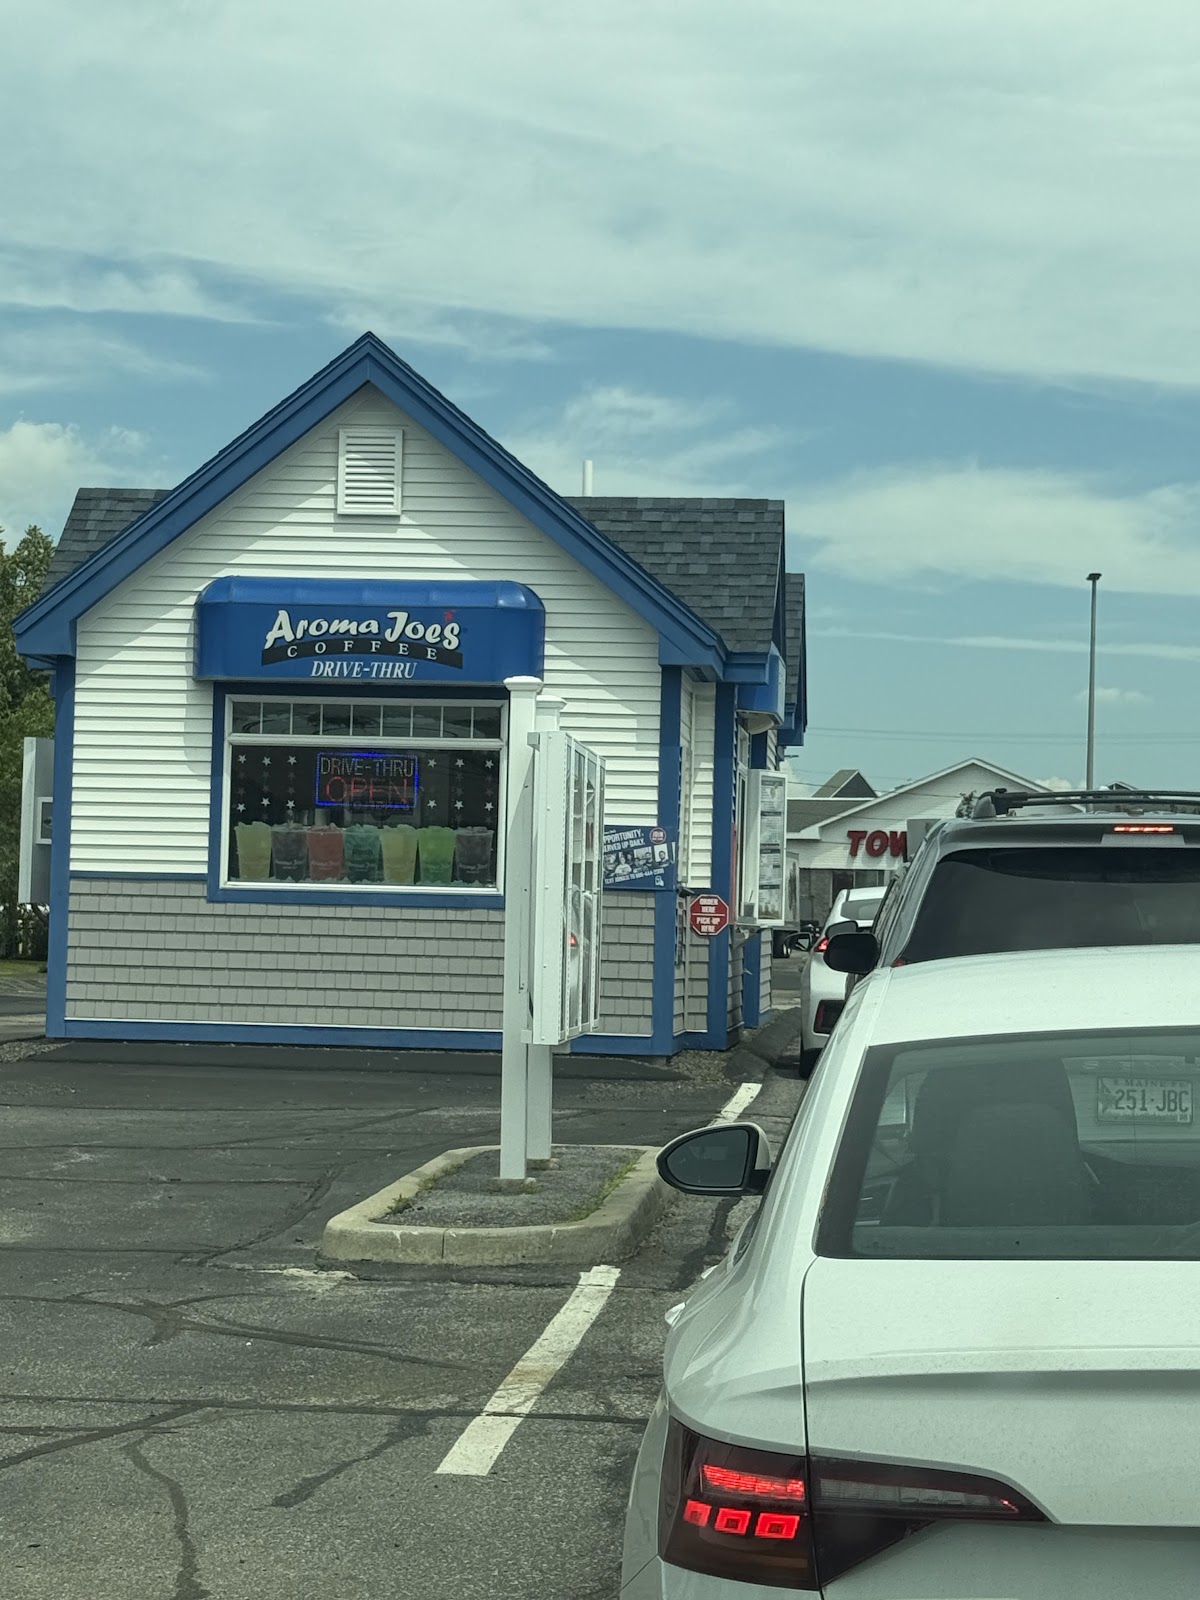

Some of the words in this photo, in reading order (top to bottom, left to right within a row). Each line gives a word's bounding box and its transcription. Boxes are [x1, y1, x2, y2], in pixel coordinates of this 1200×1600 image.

[264, 609, 380, 650] Aroma
[286, 640, 438, 660] COFFEE
[310, 660, 418, 678] DRIVE-THRU
[320, 757, 414, 777] DRIVE-THRU
[325, 776, 408, 804] OPEN
[699, 898, 718, 906] ORDER
